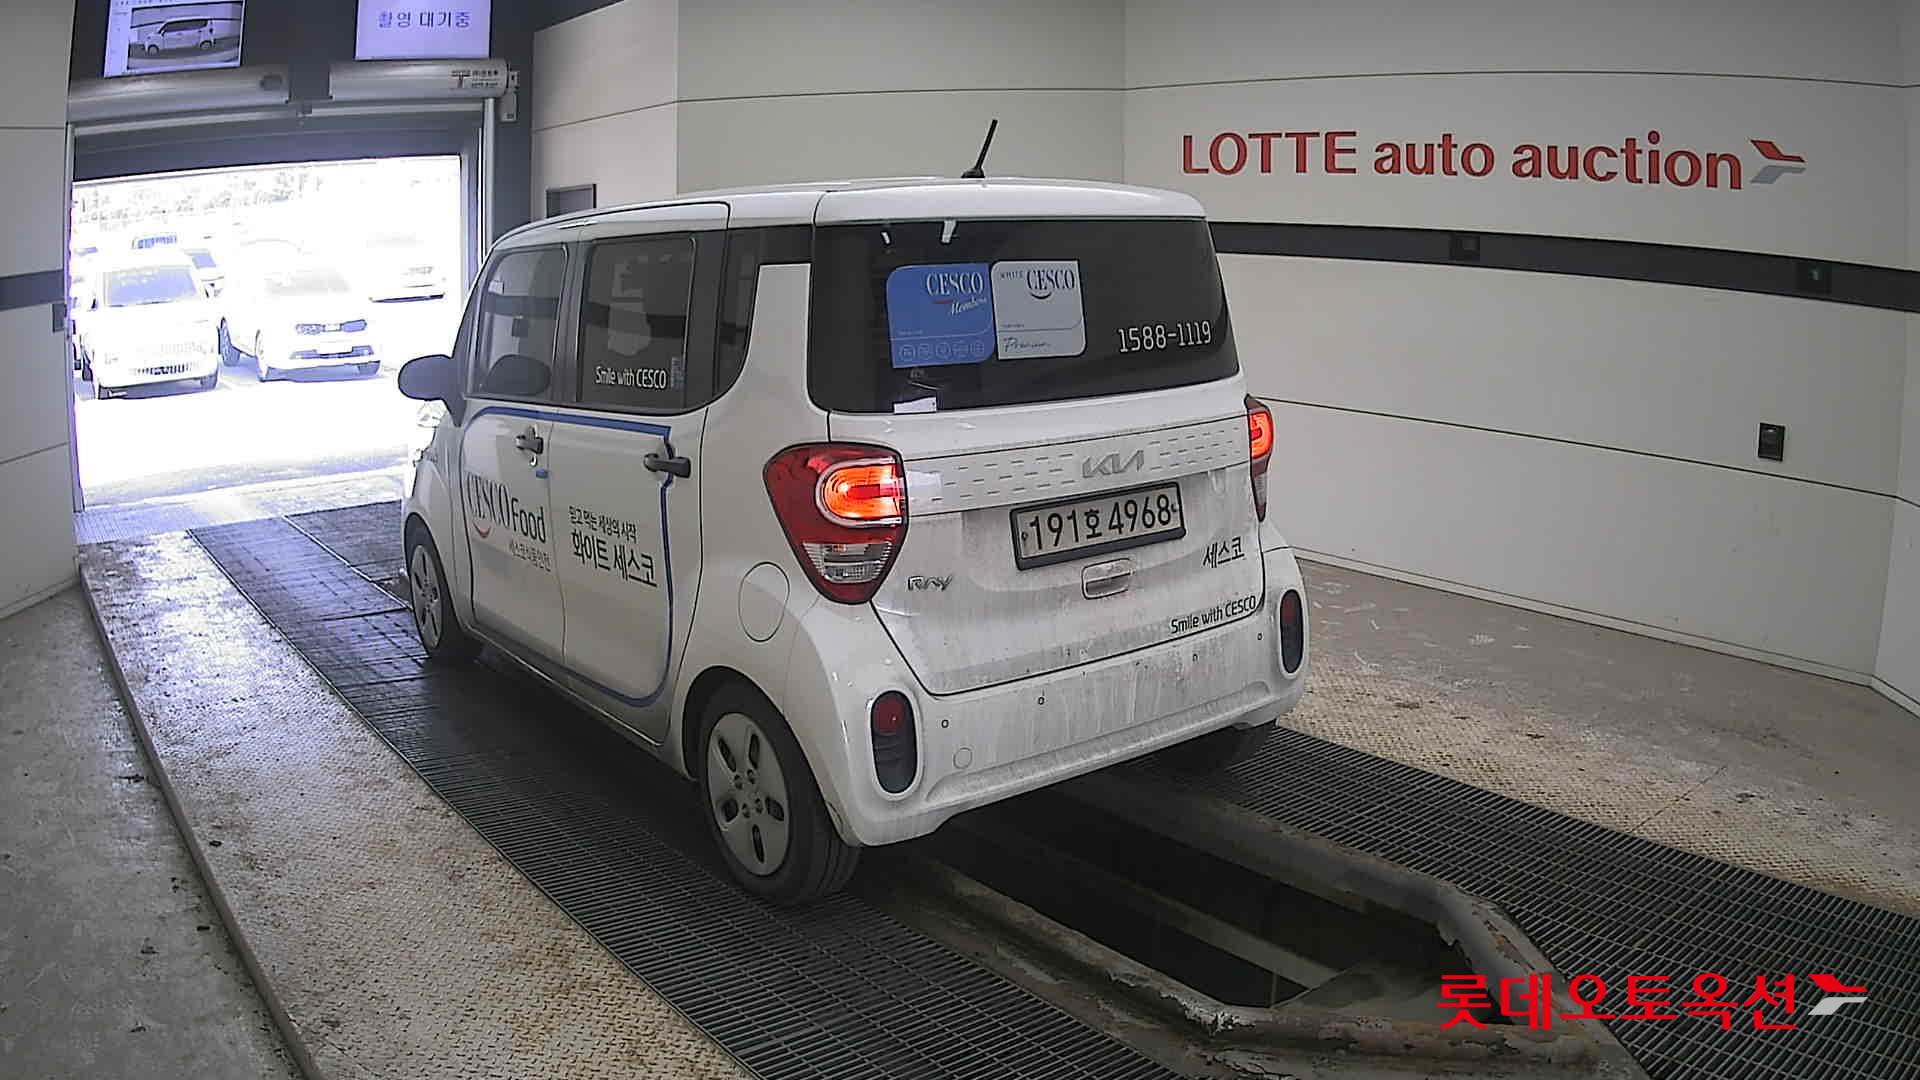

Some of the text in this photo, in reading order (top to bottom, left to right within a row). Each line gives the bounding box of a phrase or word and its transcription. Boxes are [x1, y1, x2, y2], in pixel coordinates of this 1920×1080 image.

[419, 11, 472, 28] 대기중
[1182, 130, 1744, 190] LOTTE auto auction
[926, 271, 985, 297] CESCO
[1026, 269, 1076, 291] CESCO
[1118, 320, 1212, 352] 1588-1119
[595, 366, 616, 385] Smile
[616, 367, 635, 386] with
[636, 368, 667, 389] CESCO
[1081, 450, 1145, 478] KIA
[466, 472, 546, 544] CESCO Food
[1029, 494, 1172, 550] 191호 4968
[621, 520, 637, 544] 시작
[571, 529, 658, 587] 화이트 세스코
[1202, 536, 1245, 568] 세스코
[1171, 595, 1257, 634] Smile with CESCO
